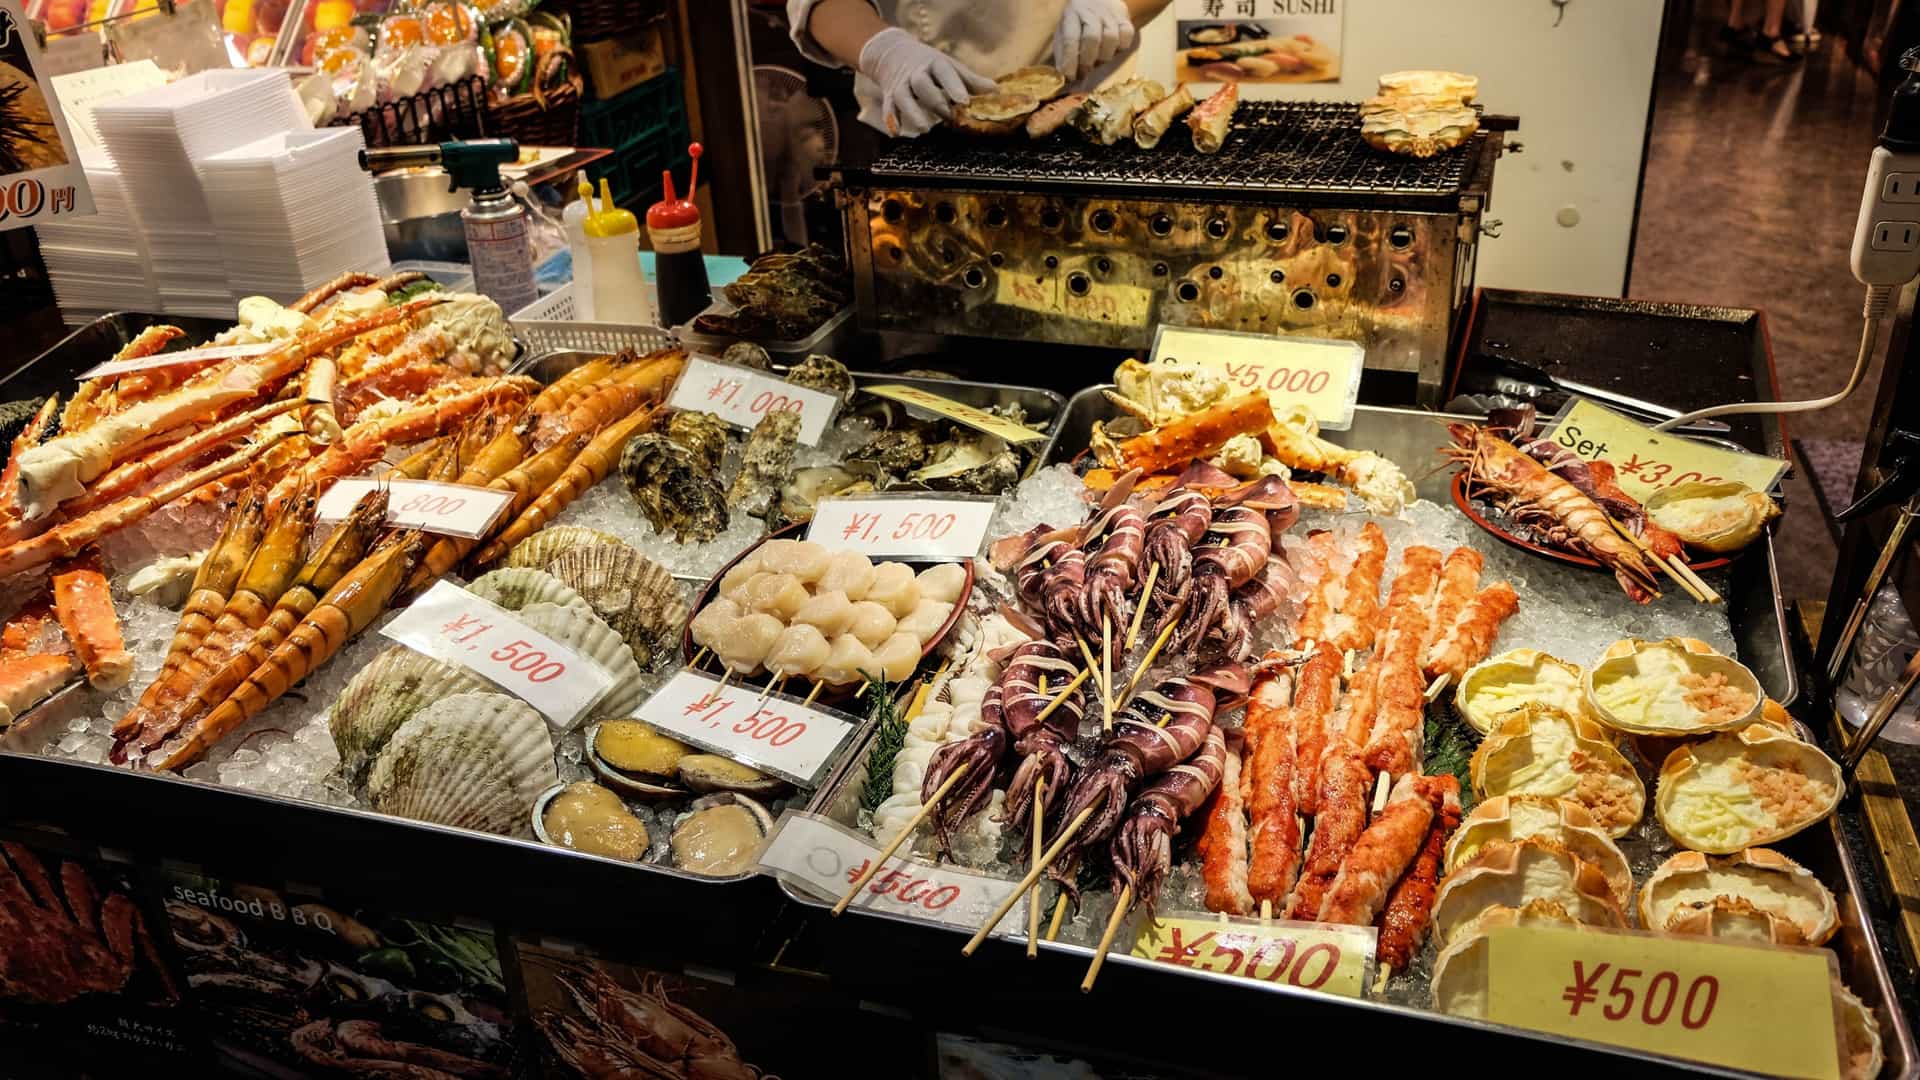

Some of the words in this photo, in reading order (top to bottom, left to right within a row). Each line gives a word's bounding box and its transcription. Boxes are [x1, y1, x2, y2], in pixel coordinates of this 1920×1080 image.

[1273, 0, 1335, 14] SUSHI
[1558, 426, 1609, 460] Set
[173, 886, 264, 918] seafood
[1155, 927, 1341, 990] ¥500
[1562, 960, 1719, 1030] ¥500
